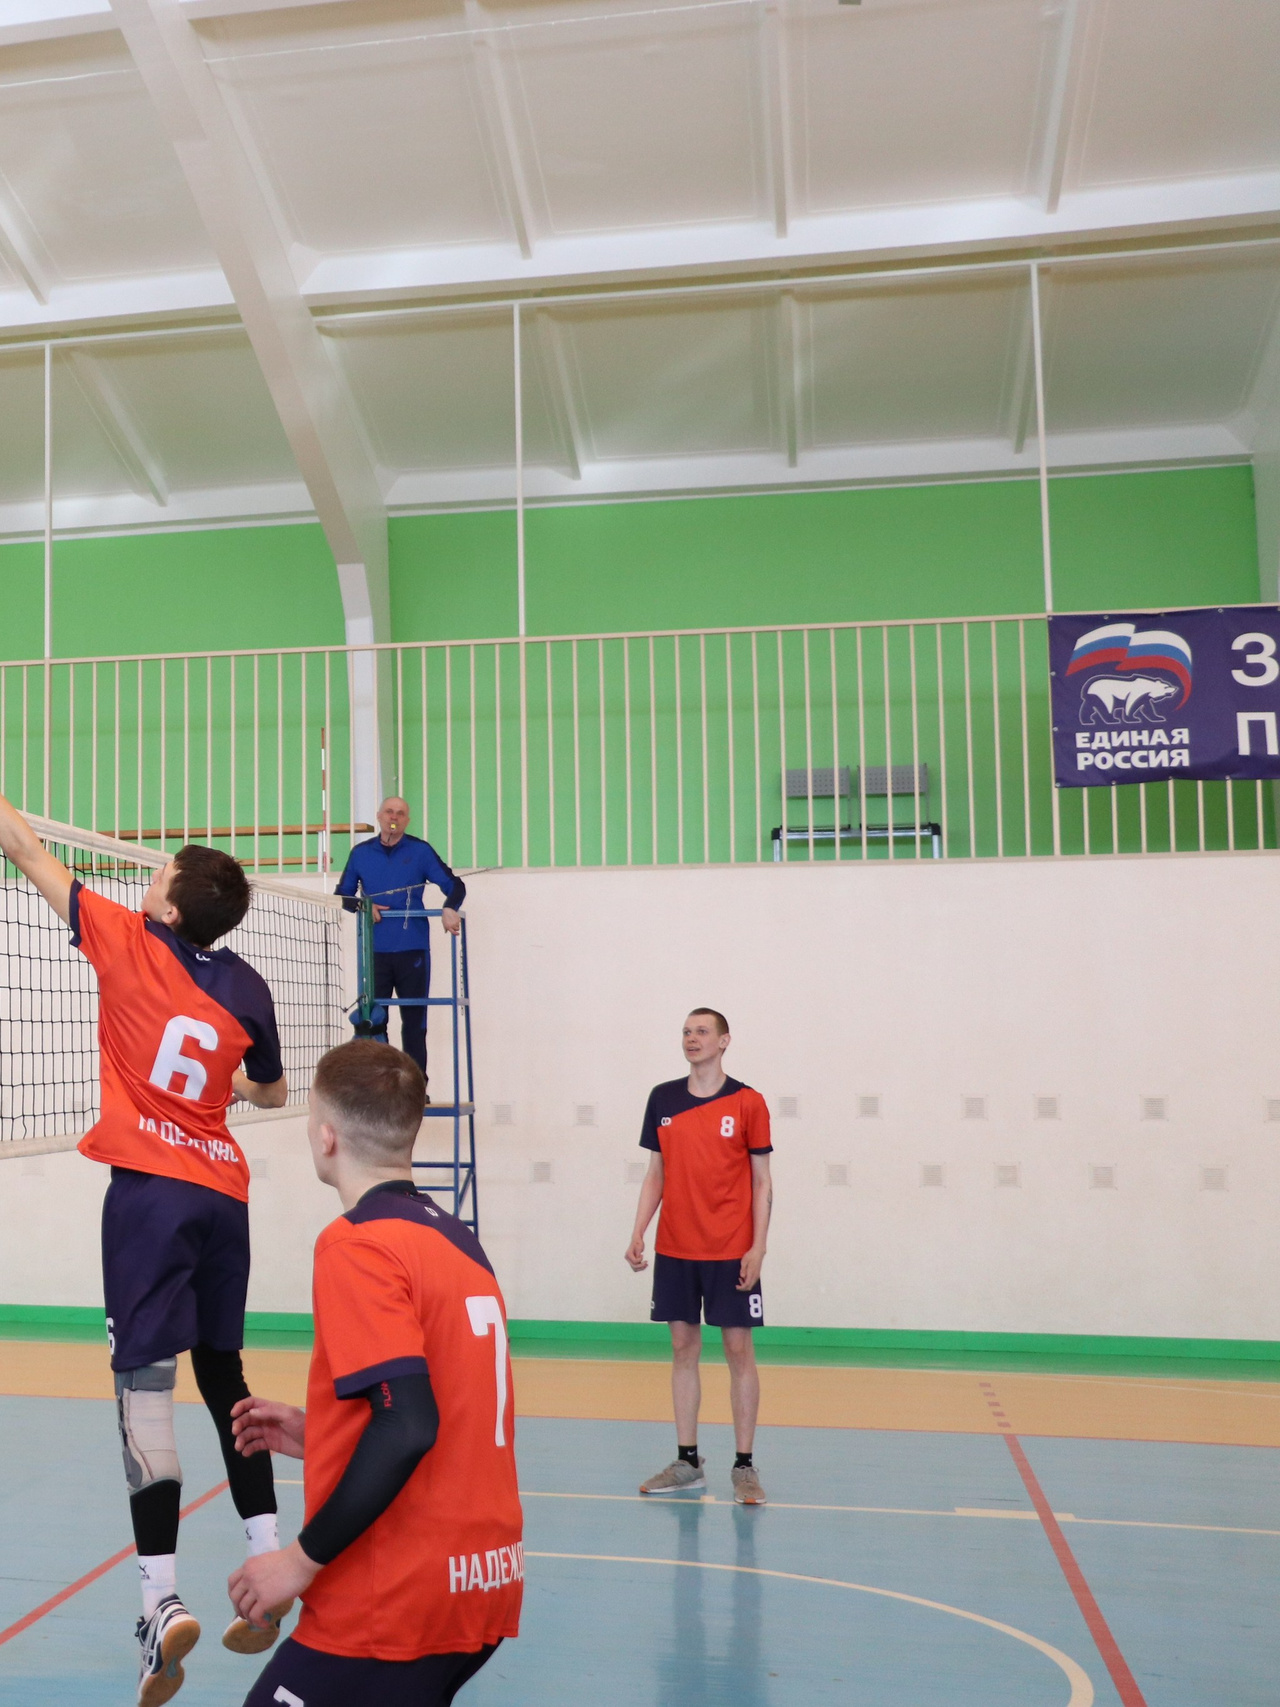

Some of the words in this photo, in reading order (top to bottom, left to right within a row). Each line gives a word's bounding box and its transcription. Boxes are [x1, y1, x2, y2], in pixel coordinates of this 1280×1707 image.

[1075, 728, 1190, 750] ЕДИНАЯ
[1236, 711, 1279, 756] П
[1076, 748, 1190, 771] РОССИЯ
[149, 1015, 219, 1101] 6
[720, 1115, 735, 1137] 8
[749, 1294, 762, 1318] 8
[465, 1295, 507, 1447] 7
